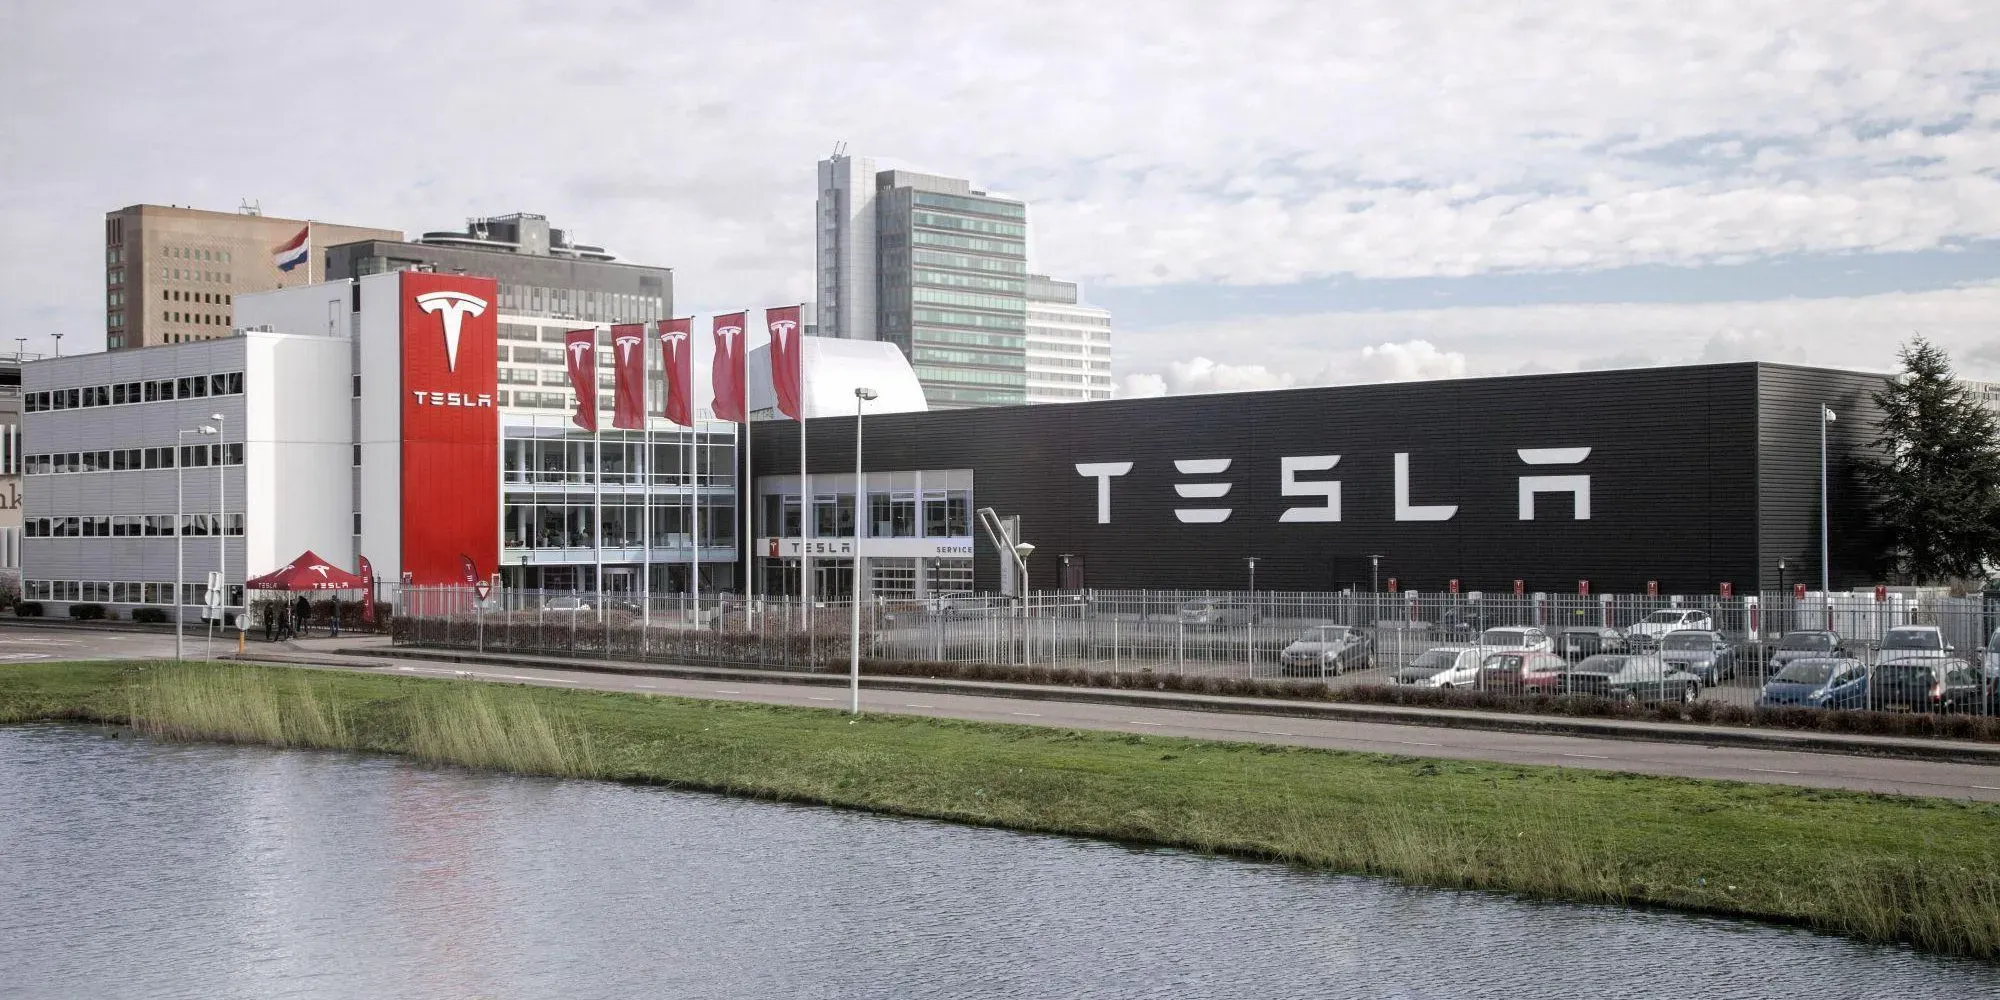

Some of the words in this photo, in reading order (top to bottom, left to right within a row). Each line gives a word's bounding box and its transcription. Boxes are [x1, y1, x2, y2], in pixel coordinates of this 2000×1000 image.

[413, 391, 491, 407] TESLA
[1075, 447, 1592, 523] TESLA
[792, 543, 850, 553] TESLA
